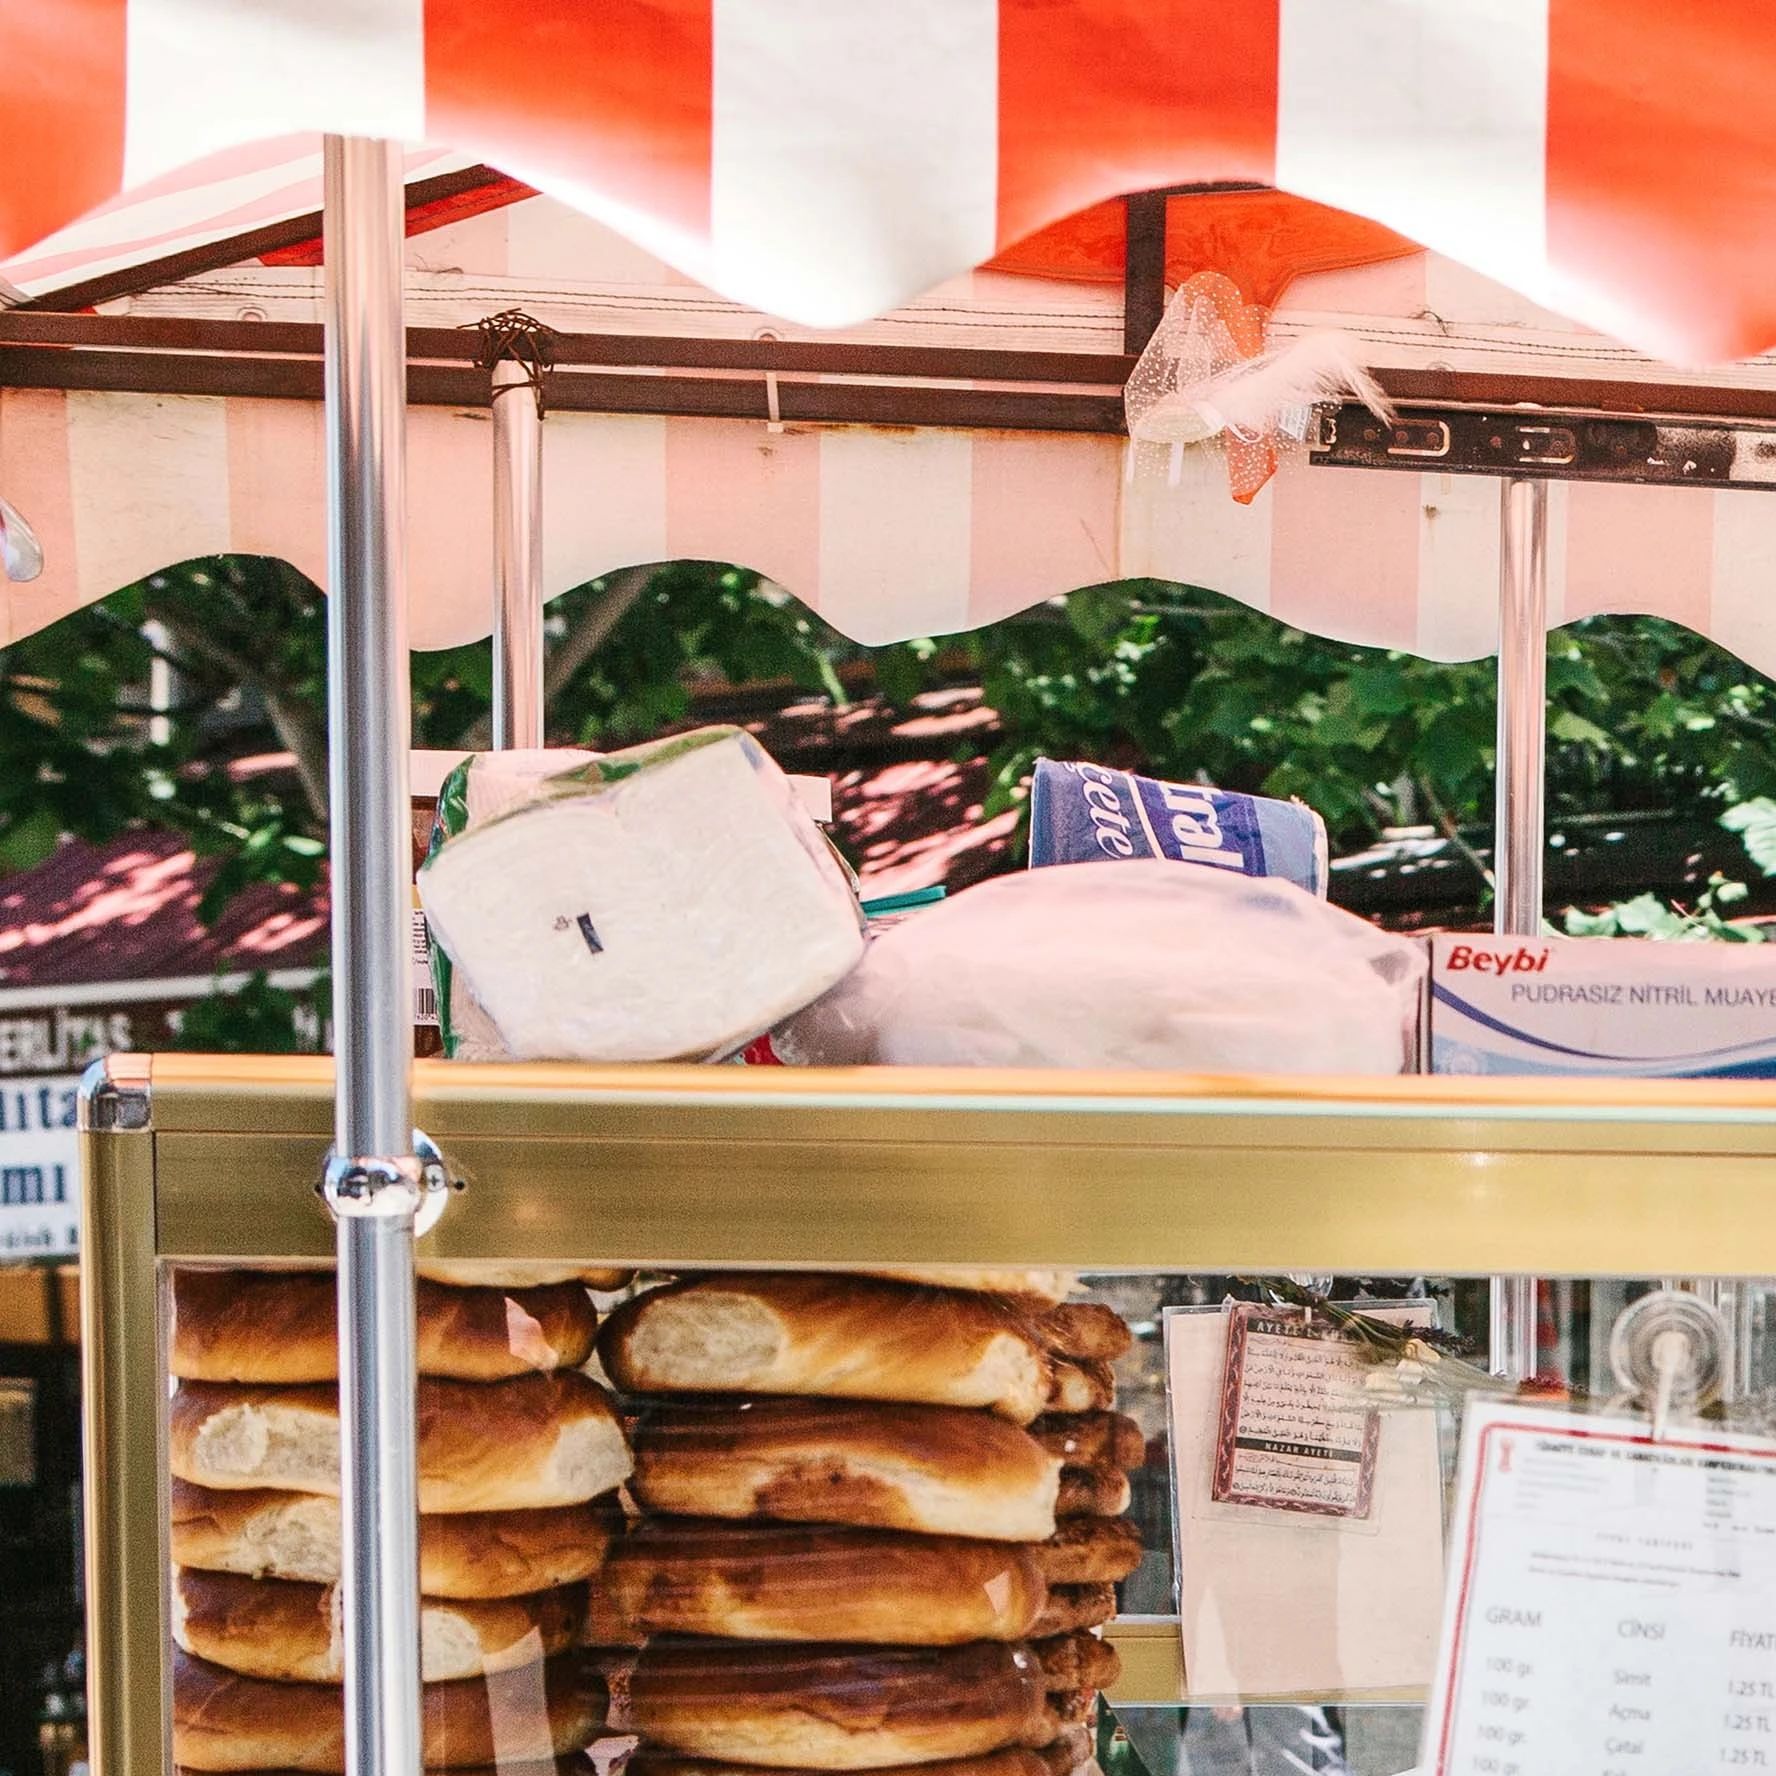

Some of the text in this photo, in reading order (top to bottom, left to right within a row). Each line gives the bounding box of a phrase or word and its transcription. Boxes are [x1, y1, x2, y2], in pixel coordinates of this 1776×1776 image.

[1446, 945, 1550, 976] Beybi
[1511, 984, 1624, 1005] PUDRASIZ
[1629, 984, 1698, 1007] NİTRİL
[1486, 1606, 1543, 1628] GRAM
[1618, 1620, 1667, 1641] CİNSİ
